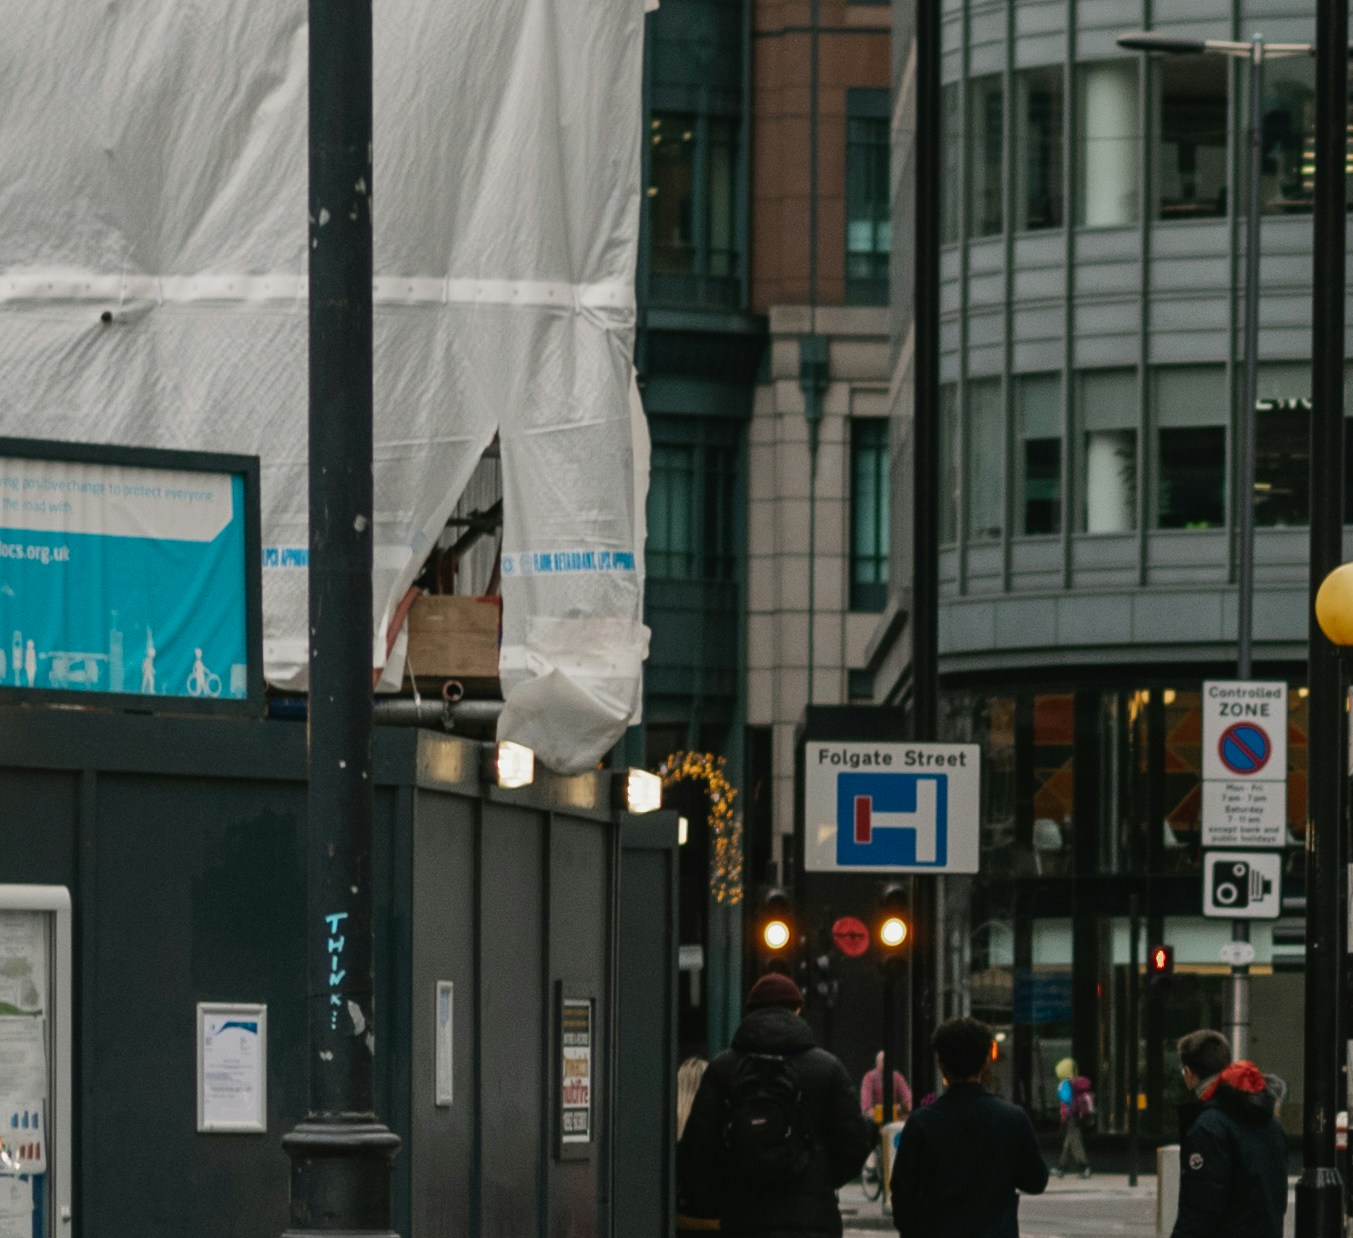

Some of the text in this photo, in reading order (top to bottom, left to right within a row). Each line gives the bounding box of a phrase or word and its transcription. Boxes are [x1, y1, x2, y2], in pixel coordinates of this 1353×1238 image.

[1209, 686, 1282, 699] Controlled
[1219, 702, 1270, 717] ZONE
[818, 749, 967, 768] Folgate Street
[1225, 805, 1264, 814] Saturday
